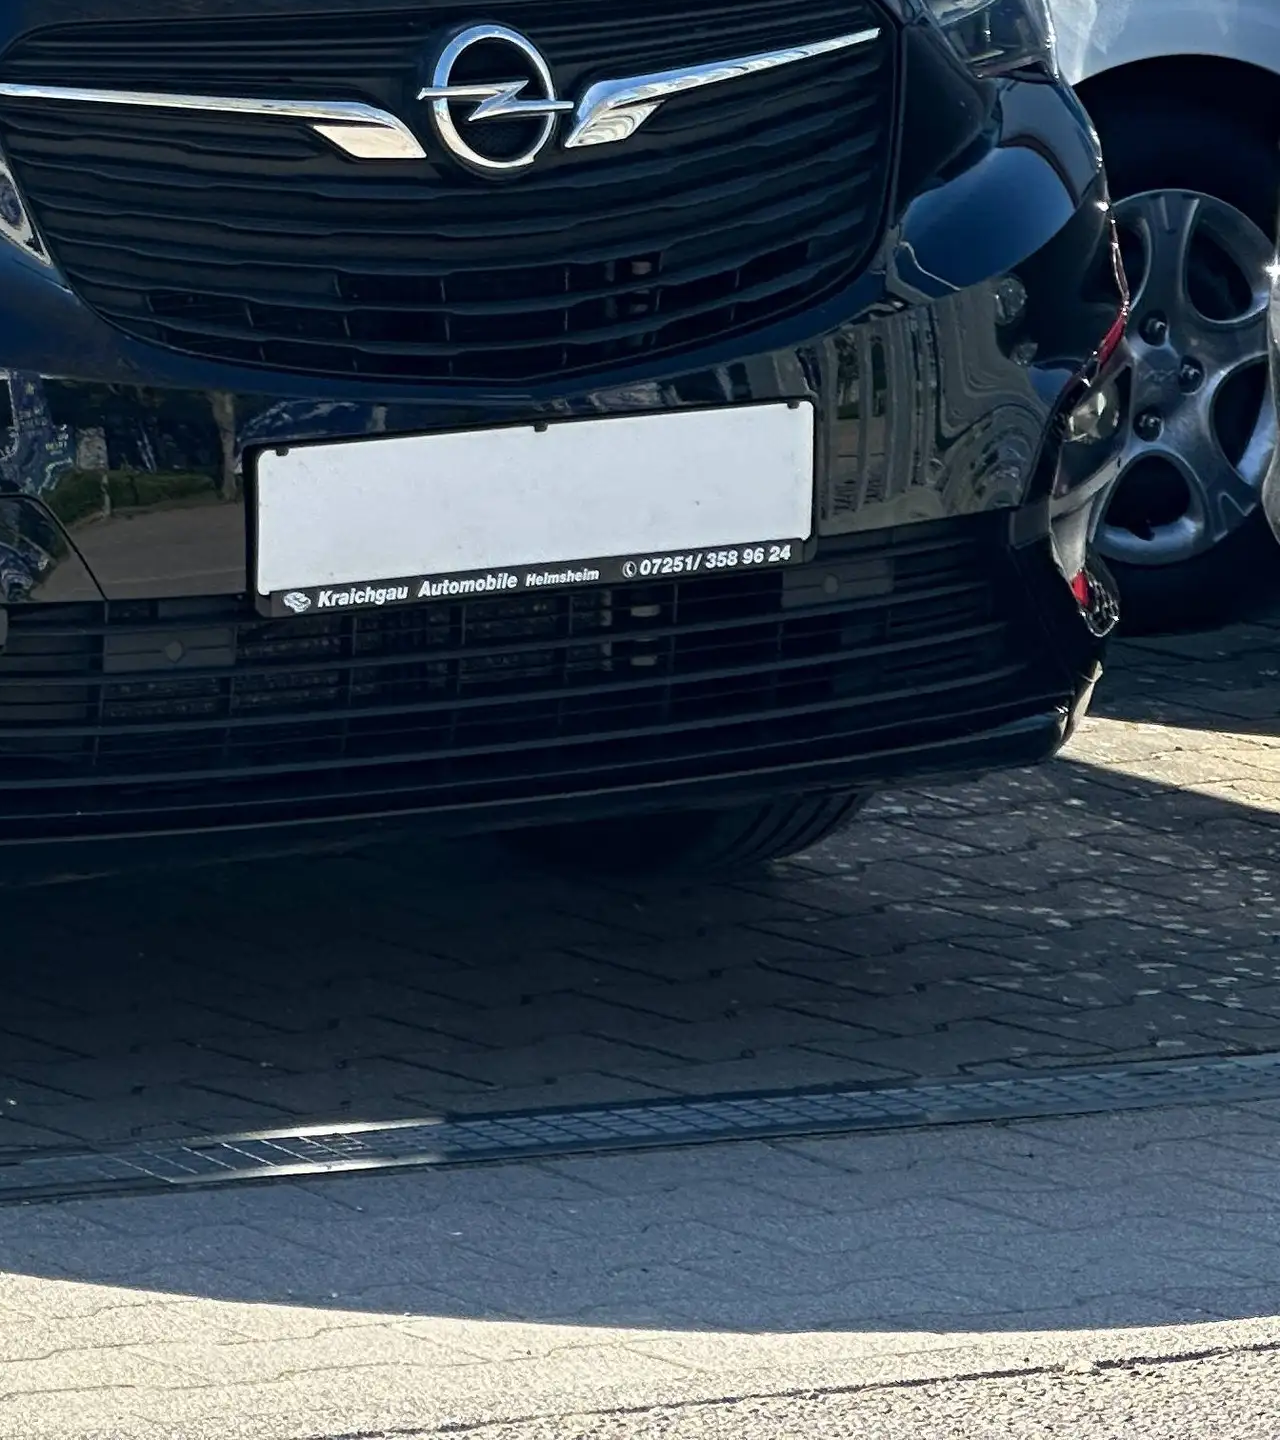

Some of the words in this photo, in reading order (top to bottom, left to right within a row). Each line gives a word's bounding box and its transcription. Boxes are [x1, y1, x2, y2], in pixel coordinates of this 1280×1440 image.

[317, 585, 409, 608] Kraichgau
[417, 572, 518, 598] Automobile
[639, 553, 703, 576] 07251/
[705, 550, 739, 569] 358
[741, 547, 765, 565] 96
[767, 544, 791, 562] 24
